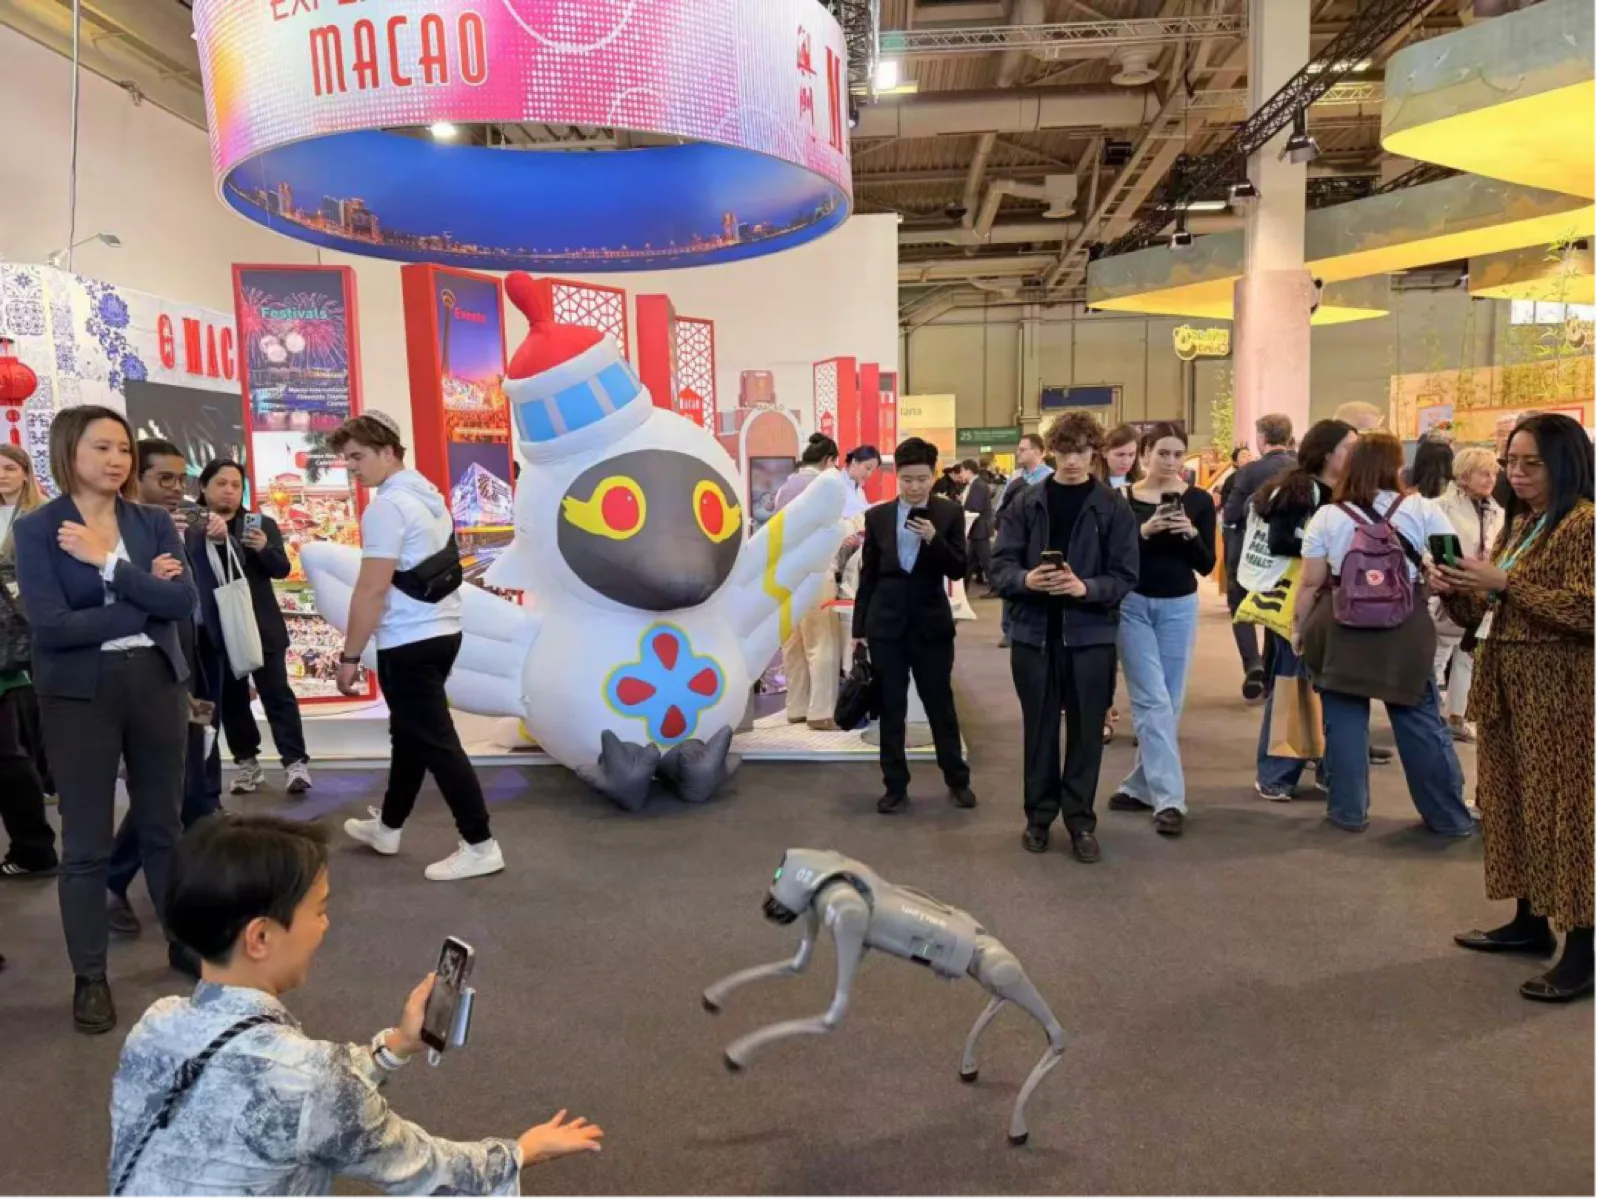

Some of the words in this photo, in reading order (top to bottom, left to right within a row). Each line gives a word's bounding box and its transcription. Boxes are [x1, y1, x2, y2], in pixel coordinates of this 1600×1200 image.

[309, 12, 487, 96] MACAO
[261, 307, 328, 320] Festivals
[182, 316, 240, 382] MAC
